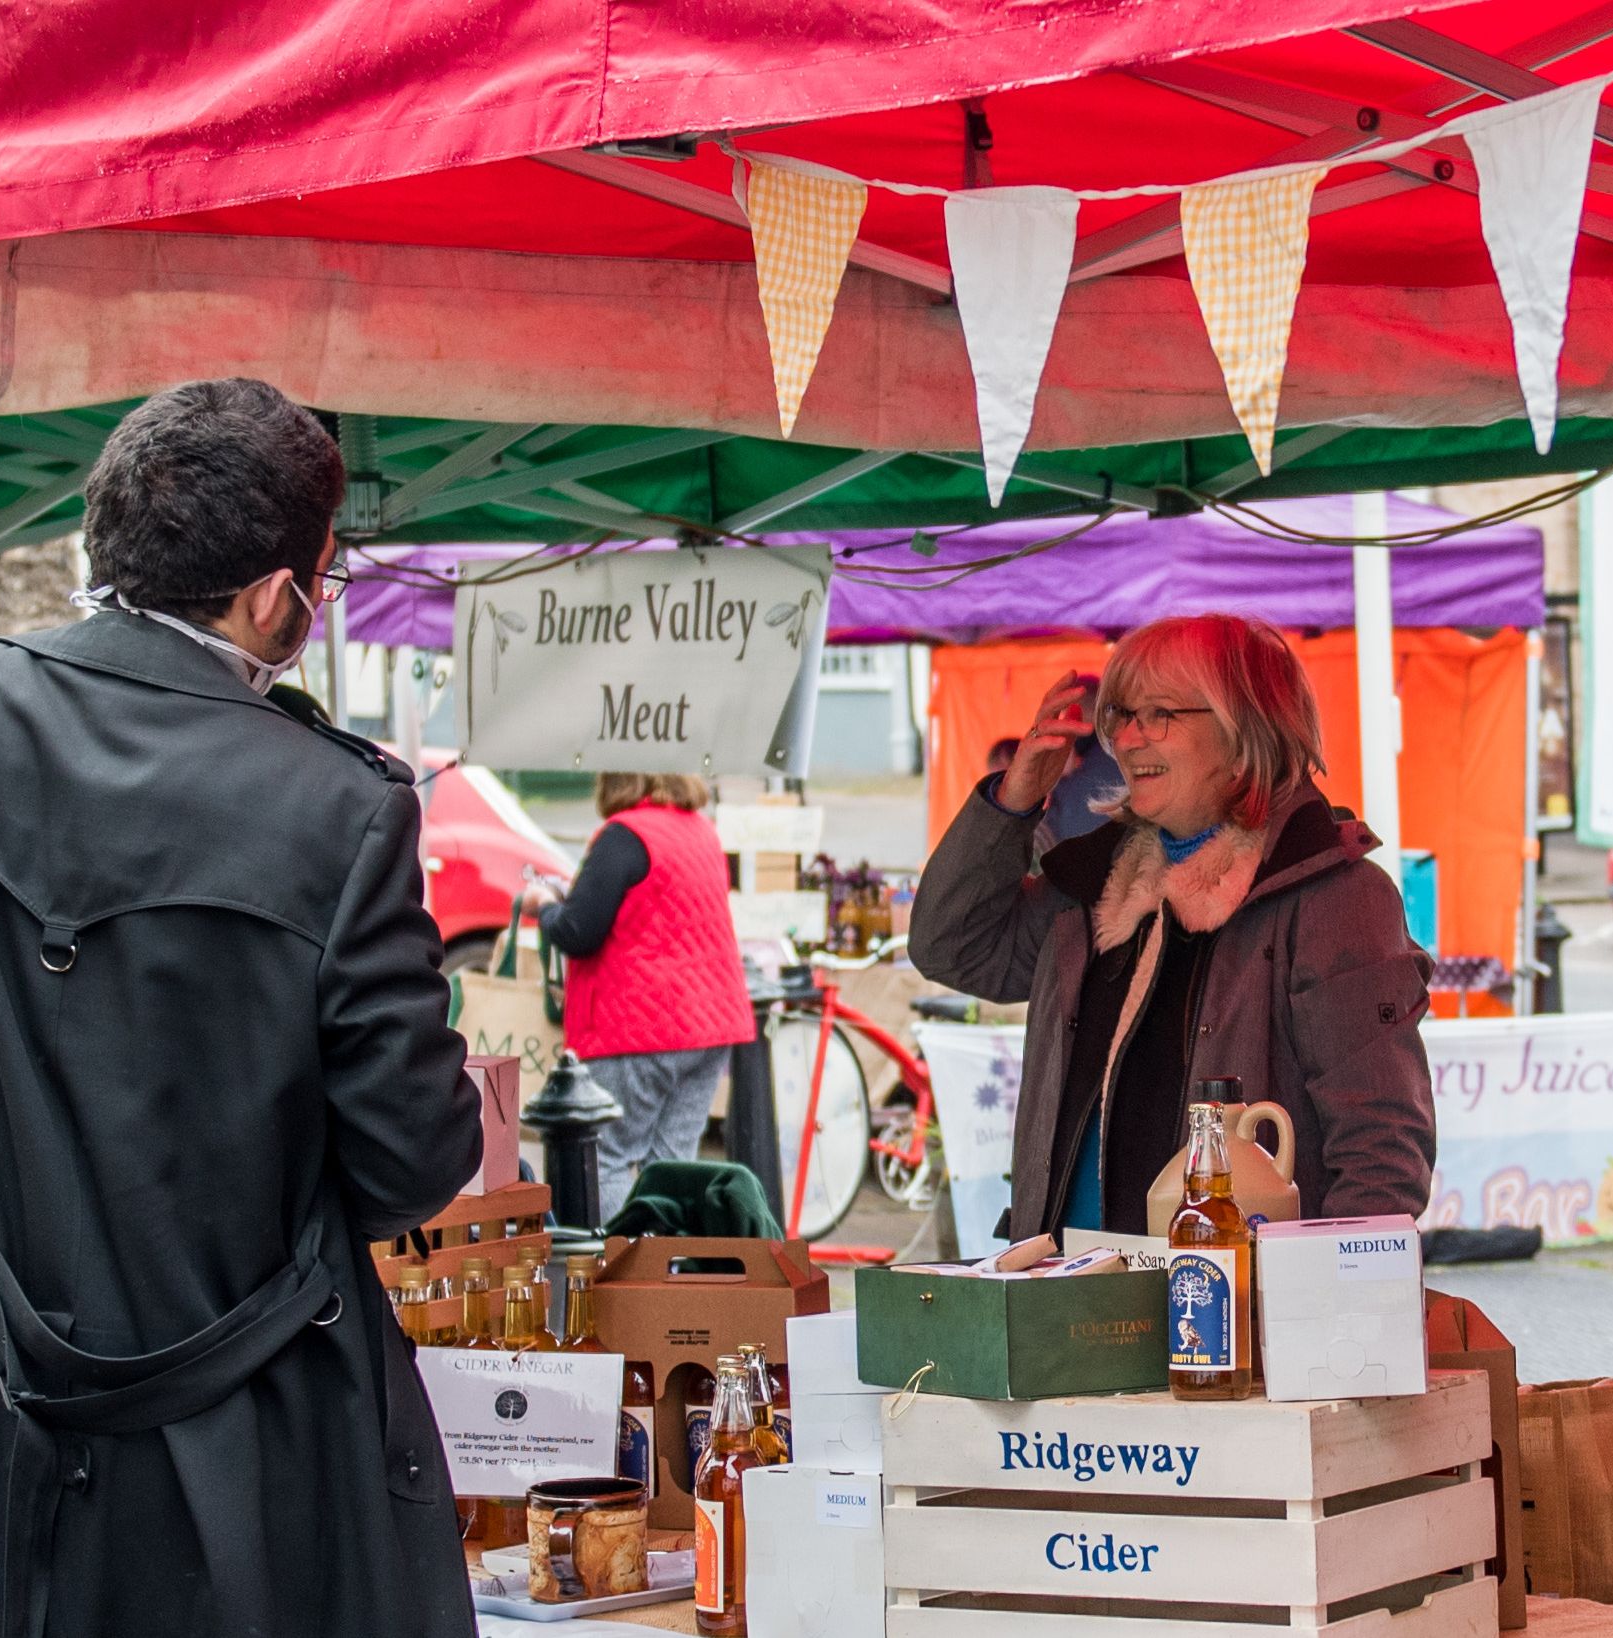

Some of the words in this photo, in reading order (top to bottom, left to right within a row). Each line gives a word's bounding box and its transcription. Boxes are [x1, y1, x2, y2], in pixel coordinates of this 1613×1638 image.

[534, 588, 633, 646] Burne
[643, 577, 758, 662] Valley
[596, 683, 691, 743] Meat
[1434, 1057, 1488, 1112] ry
[1338, 1239, 1407, 1254] MEDIUM
[1138, 1250, 1166, 1270] Soap
[1198, 1261, 1222, 1282] CIDER
[453, 1357, 501, 1373] CIDER
[505, 1359, 574, 1376] VINEGAR
[1193, 1354, 1212, 1364] OWL
[463, 1432, 498, 1442] Ridgeway
[499, 1433, 519, 1441] Cider
[997, 1431, 1200, 1487] Ridgeway
[826, 1494, 867, 1507] MEDIUM
[1045, 1532, 1160, 1573] Cider
